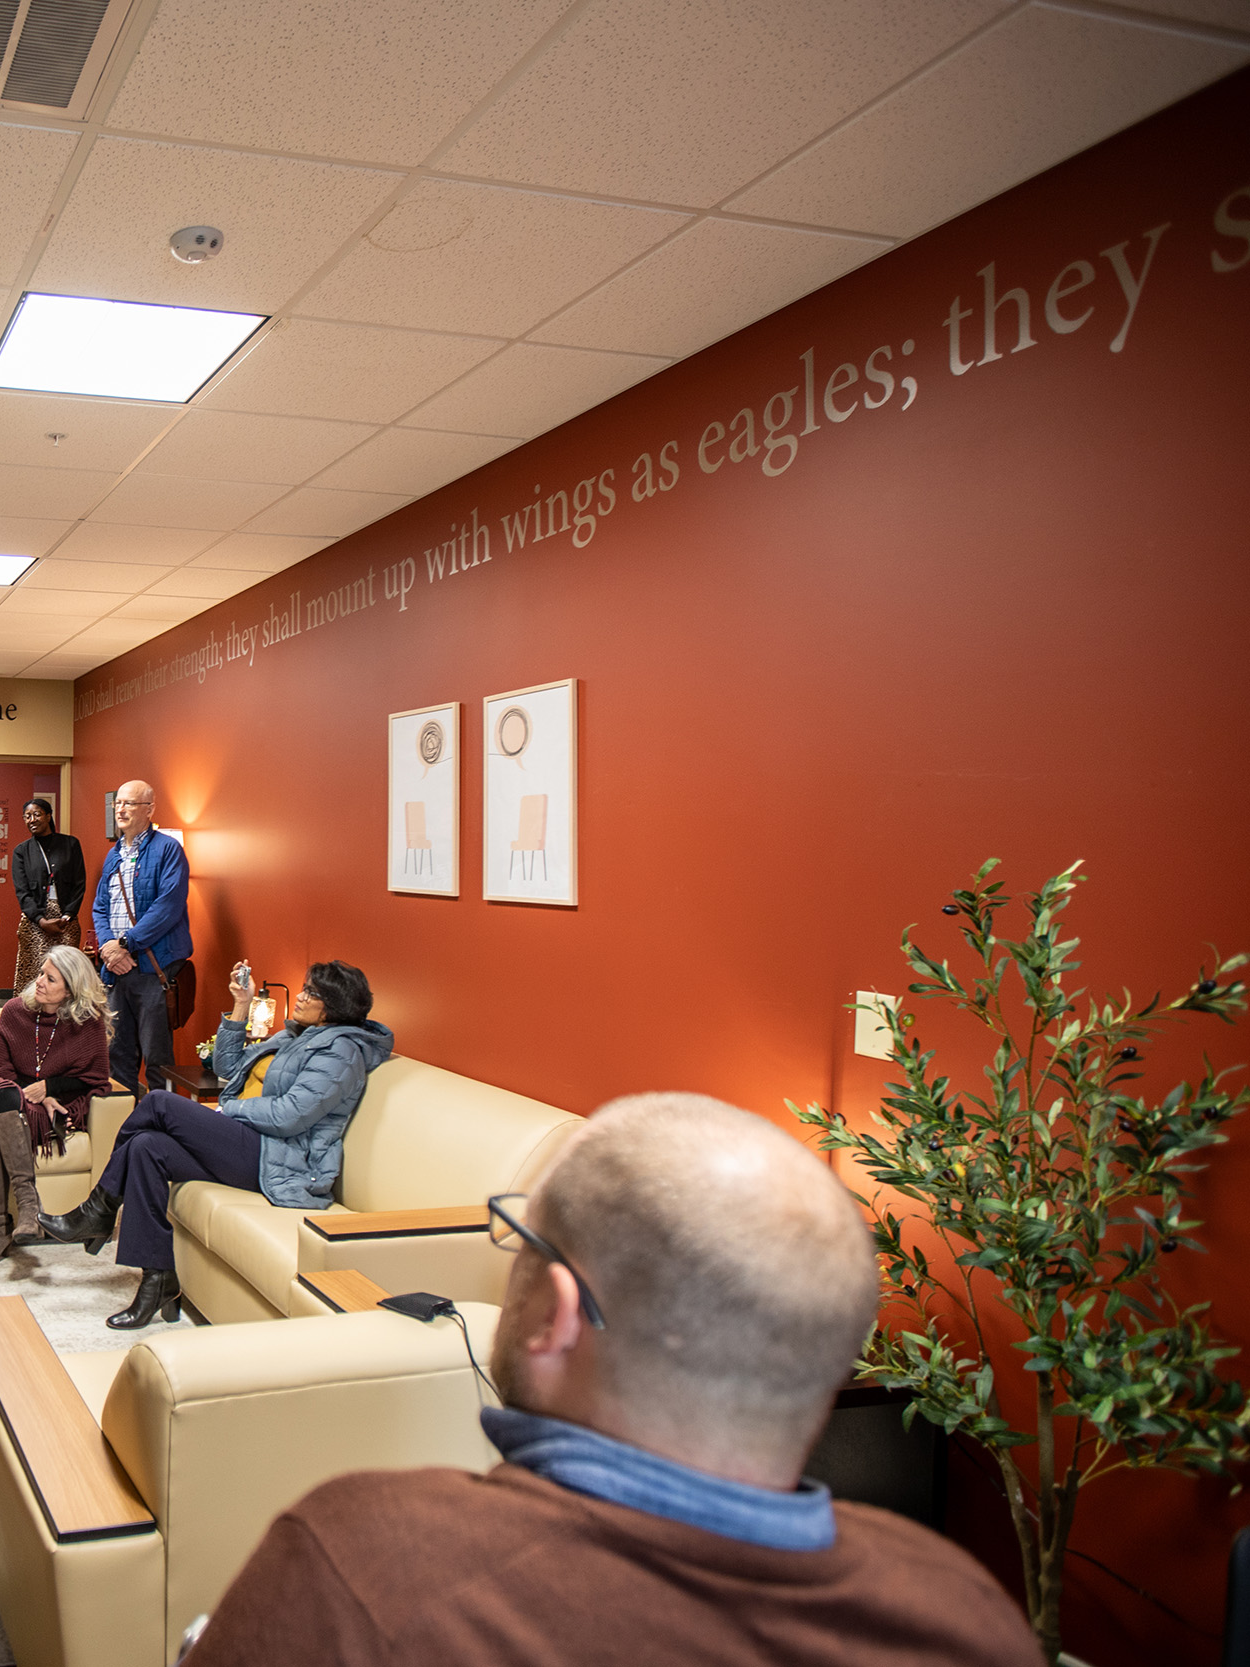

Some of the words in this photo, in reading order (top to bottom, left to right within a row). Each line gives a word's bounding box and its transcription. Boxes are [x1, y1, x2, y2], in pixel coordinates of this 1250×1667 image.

[74, 689, 95, 722] LORD
[96, 677, 114, 712] shall
[115, 674, 143, 705] renew
[144, 659, 169, 694] their
[170, 630, 224, 684] strength;
[226, 621, 259, 667] they
[261, 595, 302, 648] shall
[306, 564, 377, 631] mount
[382, 554, 416, 612] up
[423, 506, 493, 584] with
[500, 466, 615, 549] wings
[630, 439, 681, 503] as
[696, 338, 919, 478] eagles;
[941, 220, 1172, 376] they
